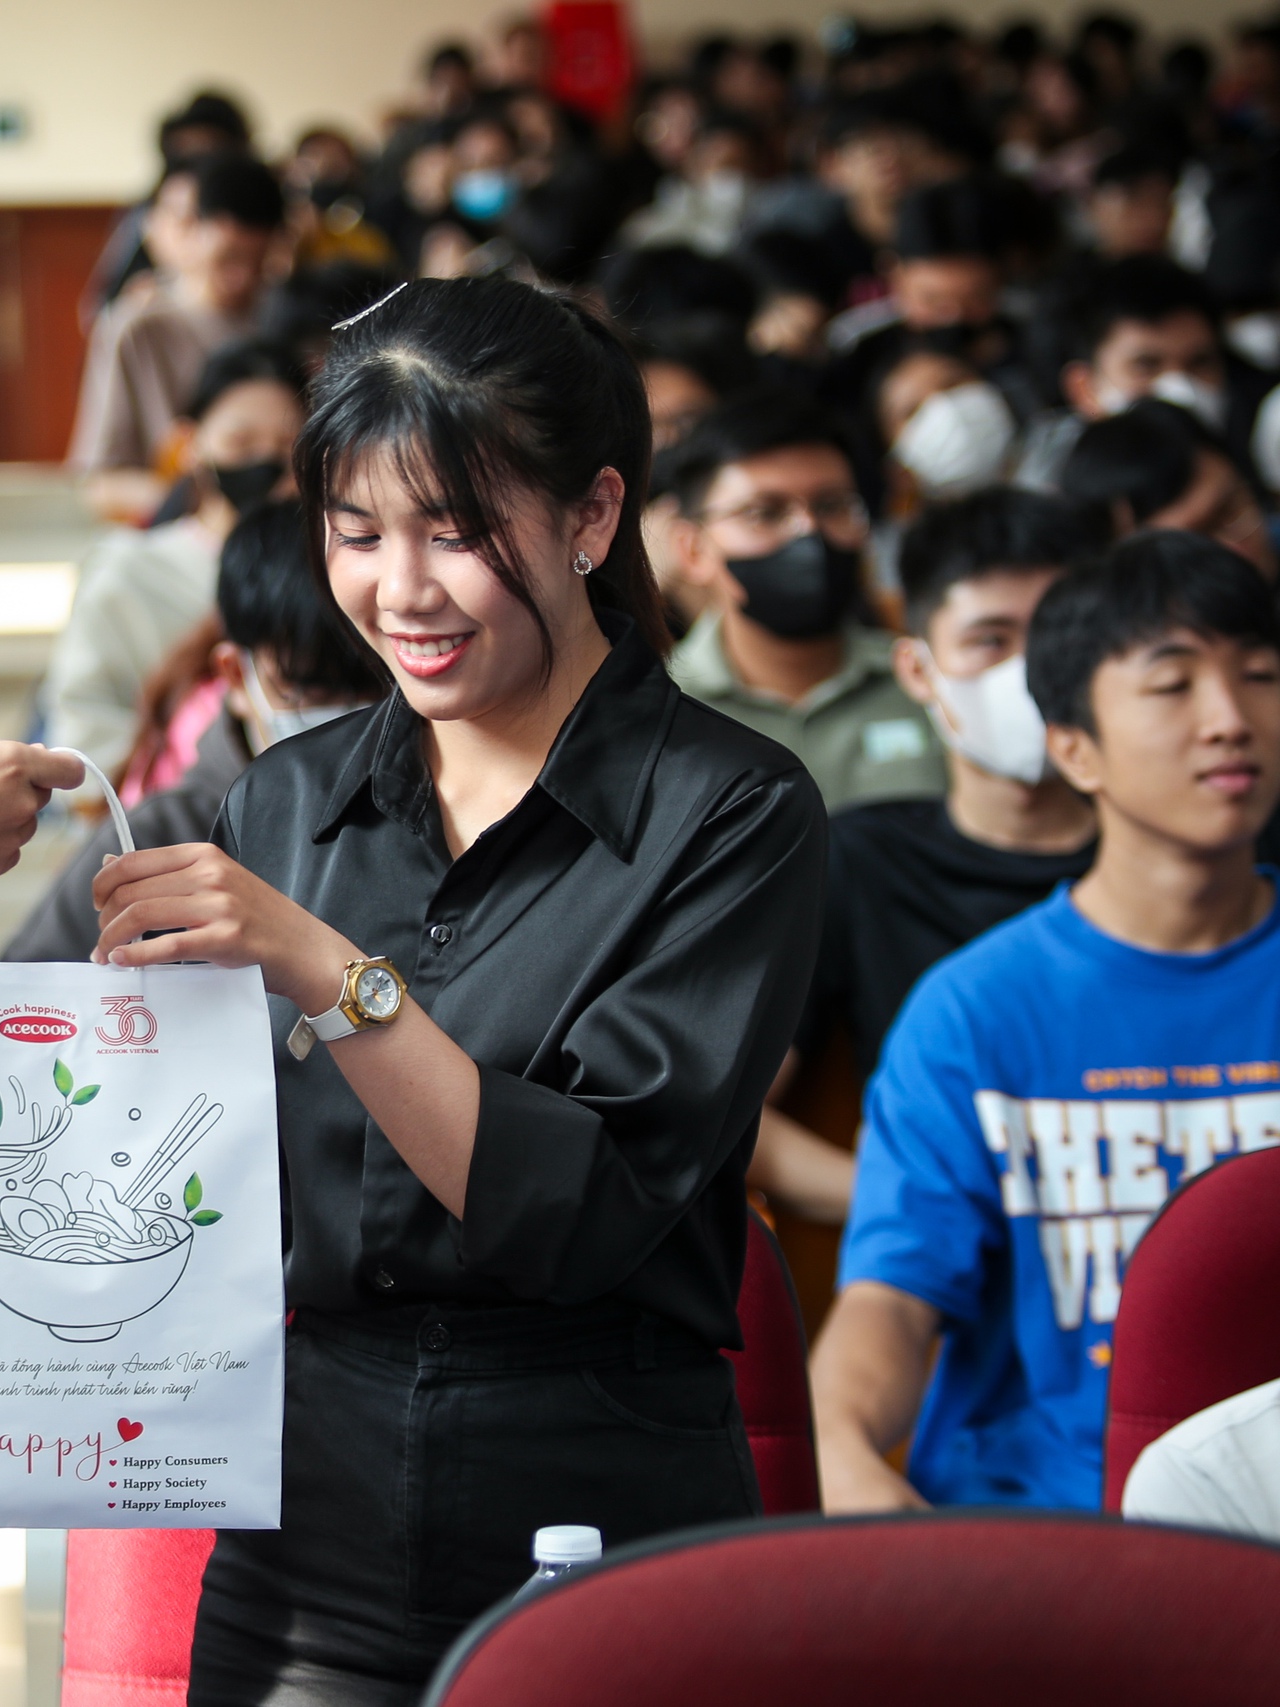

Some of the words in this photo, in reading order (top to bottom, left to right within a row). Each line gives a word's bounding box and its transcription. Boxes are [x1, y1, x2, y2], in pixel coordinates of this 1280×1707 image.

[24, 1004, 77, 1020] happiness
[95, 995, 158, 1046] 30
[1171, 1064, 1222, 1088] THE
[46, 1357, 83, 1372] hành
[86, 1360, 118, 1379] cùng
[122, 1352, 175, 1374] Acecook
[176, 1351, 207, 1373] Việt
[209, 1351, 249, 1372] Nam
[123, 1457, 161, 1469] Happy
[165, 1455, 228, 1467] Consumers
[123, 1478, 161, 1491] Happy
[165, 1477, 207, 1490] Society
[122, 1500, 161, 1512] Happy
[164, 1498, 226, 1511] Employees
